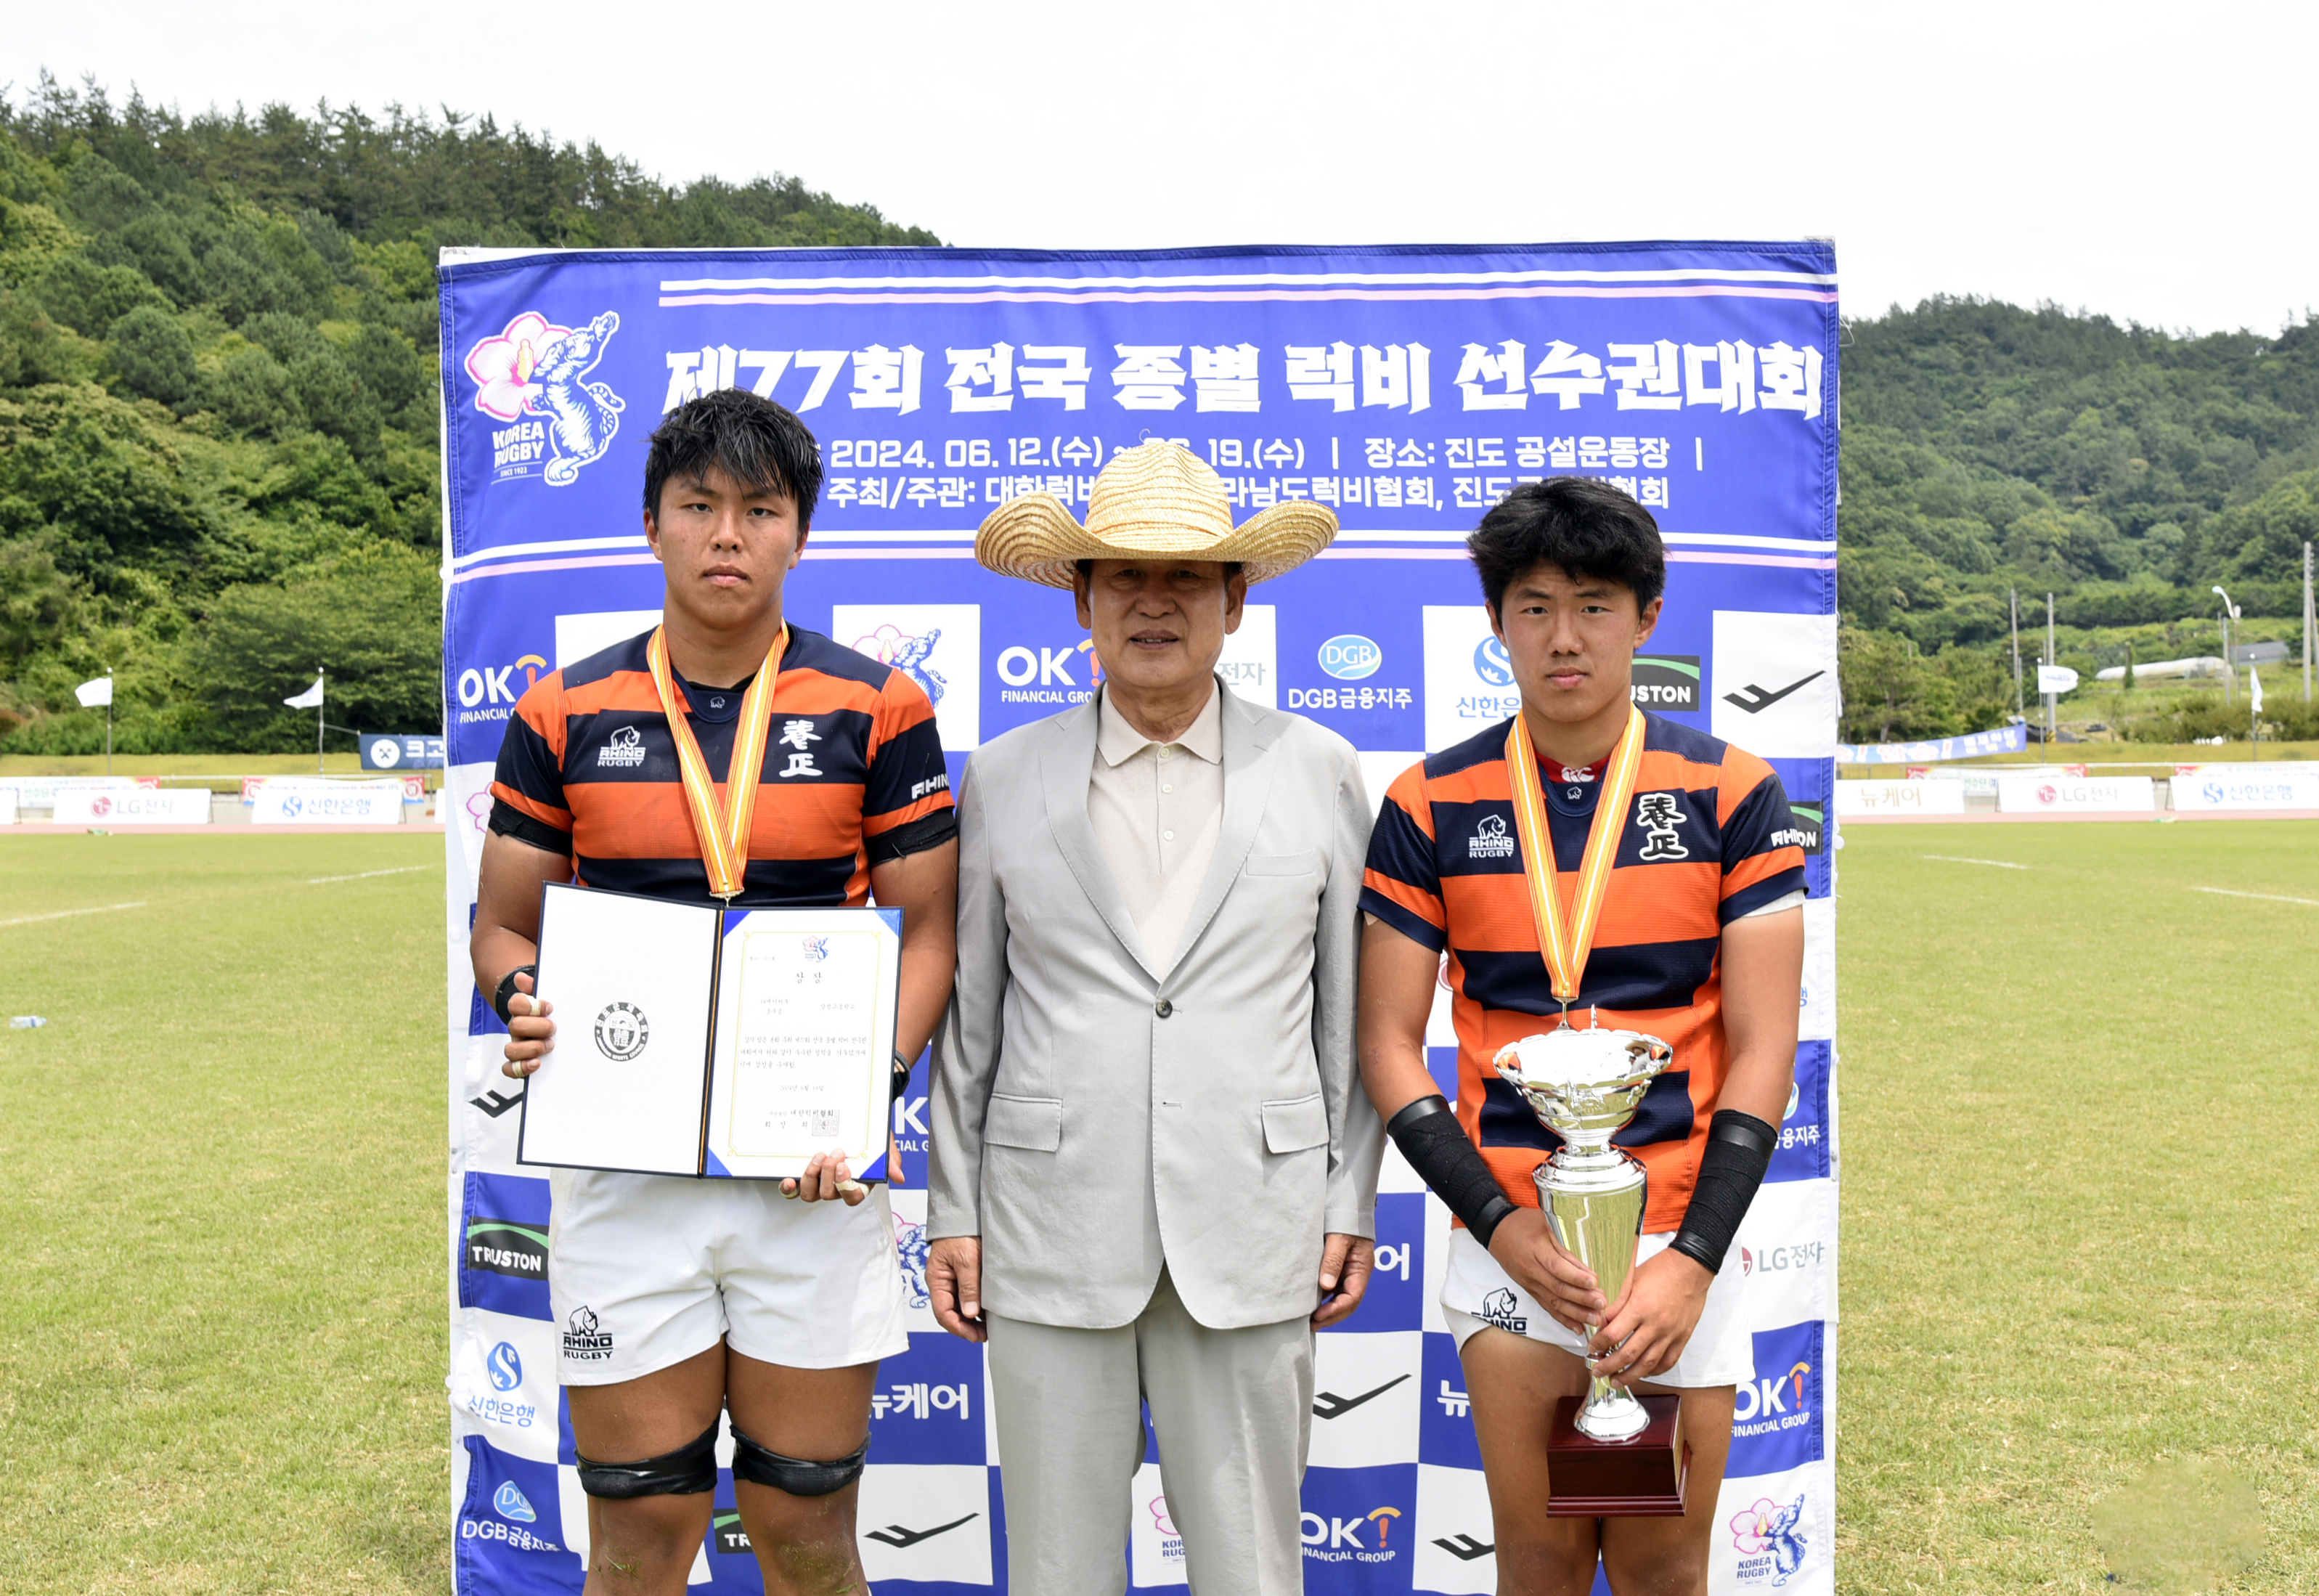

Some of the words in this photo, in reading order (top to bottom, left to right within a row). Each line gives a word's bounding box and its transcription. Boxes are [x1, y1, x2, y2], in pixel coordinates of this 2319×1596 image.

[662, 343, 925, 416] 제77회
[943, 340, 1093, 414] 전국
[1110, 341, 1262, 413] 종별
[1284, 339, 1432, 415] 럭비
[1453, 338, 1824, 420] 선수권대회
[492, 421, 545, 449] KOREA
[494, 440, 545, 469] RUGBY
[830, 439, 935, 468] 2024.
[945, 439, 1000, 468] 06.
[1008, 436, 1104, 468] 12.(수)
[1208, 437, 1305, 469] 19.(수)
[1364, 437, 1435, 468] 장소:
[1444, 436, 1508, 468] 진도
[1515, 436, 1671, 468] 공설운동장
[500, 468, 513, 478] SINCE
[514, 466, 528, 475] 1923
[826, 476, 976, 510] 주최/주관:
[1225, 476, 1443, 511] 라남도럭비협회,
[1326, 645, 1373, 664] DGB
[997, 646, 1077, 686] OK
[1217, 661, 1266, 685] 전자
[458, 665, 516, 707] OK
[1630, 685, 1691, 703] USTON
[1001, 690, 1065, 704] FINANCIAL
[1067, 691, 1093, 704] GRO
[1288, 687, 1413, 709] DGB금융지주
[1456, 696, 1522, 718] 신한은
[460, 708, 509, 724] FINANCIAL
[599, 749, 645, 757] RHINO
[911, 773, 950, 799] RHIN
[2230, 784, 2293, 800] 신한은행
[308, 797, 372, 815] 신한은행
[1860, 786, 1923, 807] 뉴케어
[1469, 839, 1514, 848] RHINO
[1469, 850, 1514, 858] RUGBY
[472, 1245, 542, 1272] TRUSTON
[563, 1336, 613, 1348] RHINO
[563, 1350, 613, 1360] RUGBY
[1733, 1375, 1788, 1421] OK
[468, 1394, 536, 1428] 신한은행
[1781, 1412, 1811, 1429] GROUP
[1300, 1512, 1365, 1549] OK
[1300, 1546, 1353, 1562] INANCIAL
[1356, 1550, 1396, 1563] GROUP
[1738, 1556, 1772, 1570] KOREA
[1736, 1566, 1771, 1579] RUGBY
